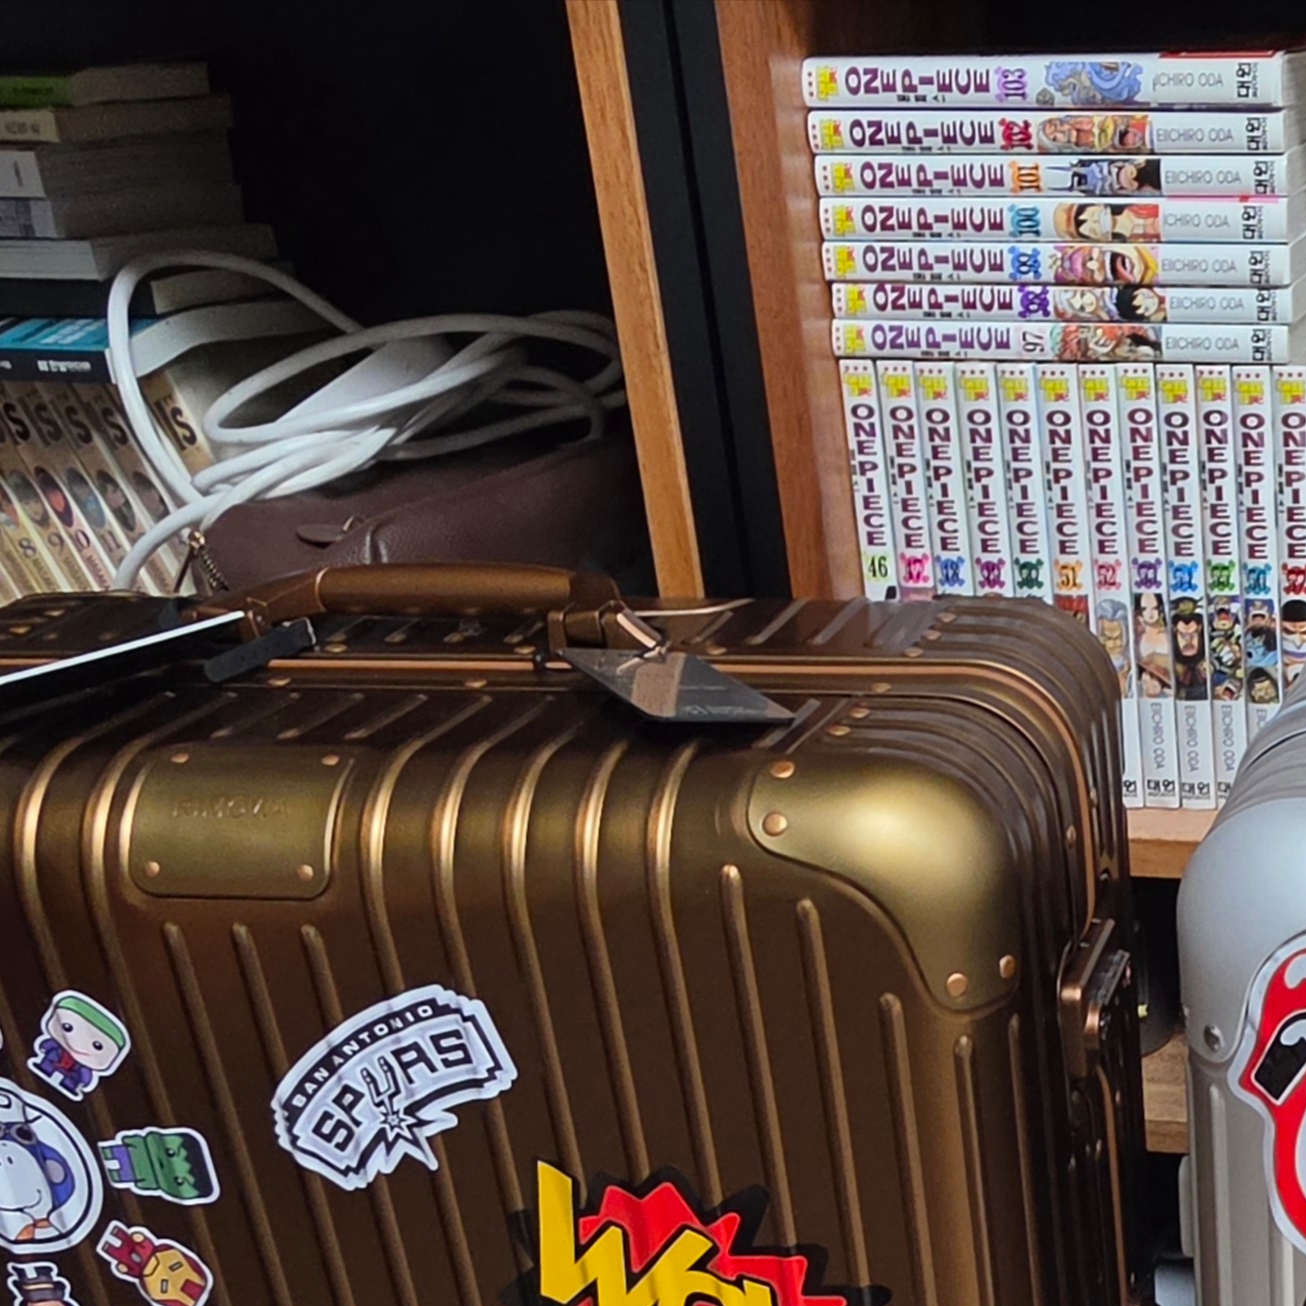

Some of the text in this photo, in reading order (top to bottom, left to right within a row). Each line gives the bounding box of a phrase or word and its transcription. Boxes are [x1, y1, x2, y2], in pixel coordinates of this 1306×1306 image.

[845, 66, 990, 95] ONE PIECE
[1001, 68, 1027, 99] 103
[849, 119, 995, 147] ONE PIECE
[860, 161, 1005, 190] ONE PIECE
[1017, 163, 1040, 191] 101
[861, 204, 1004, 232] ONE PIECE
[1016, 207, 1041, 237] 100
[863, 245, 1004, 273] ONE PIECE
[873, 283, 1013, 312] ONE PIECE
[871, 324, 1011, 352] ONE PIECE
[1022, 331, 1045, 353] 97
[850, 403, 888, 547] ONE PIECE
[1046, 409, 1079, 555] ONE PIECE
[1086, 409, 1118, 554] ONE PIECE
[867, 555, 889, 578] 46
[311, 1028, 475, 1153] SPURS
